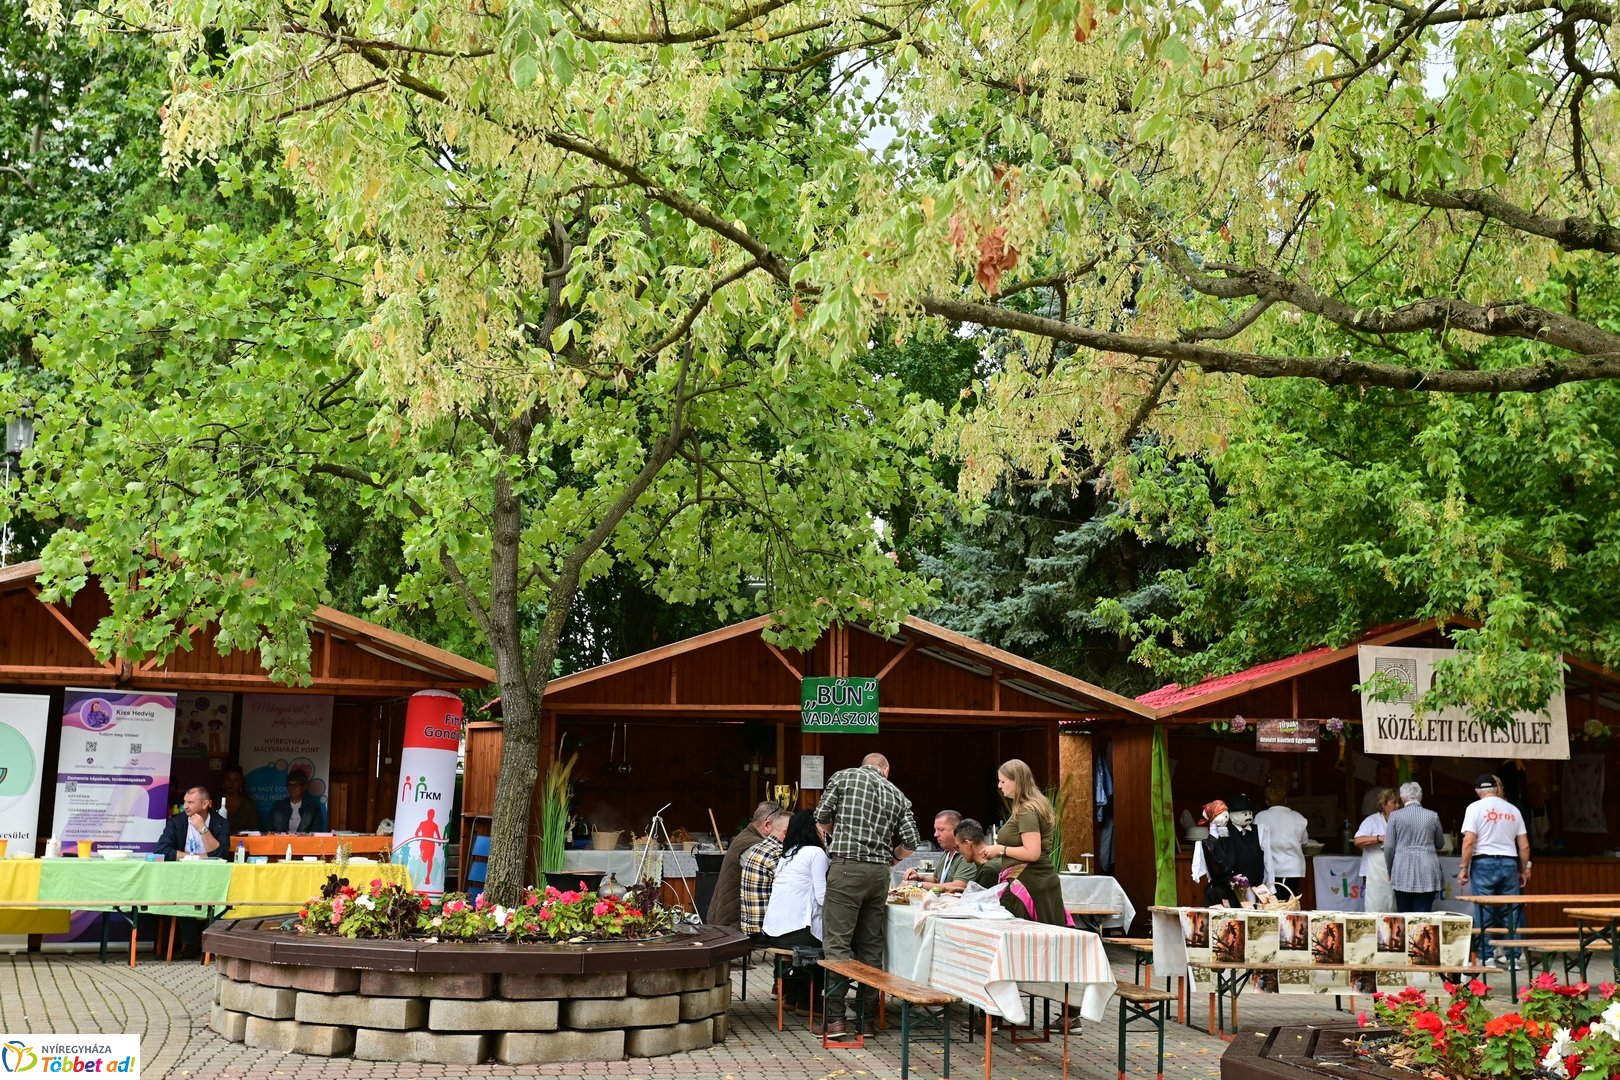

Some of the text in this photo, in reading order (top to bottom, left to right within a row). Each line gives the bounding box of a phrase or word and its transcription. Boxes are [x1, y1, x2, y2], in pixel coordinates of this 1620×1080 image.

[132, 710, 155, 718] Hedvig
[802, 708, 878, 726] VADÁSZOK
[1377, 714, 1551, 744] KÖZÉLETI EGYESÜLET
[264, 736, 310, 745] NYÍREGYHÁZA
[419, 791, 442, 800] TKM
